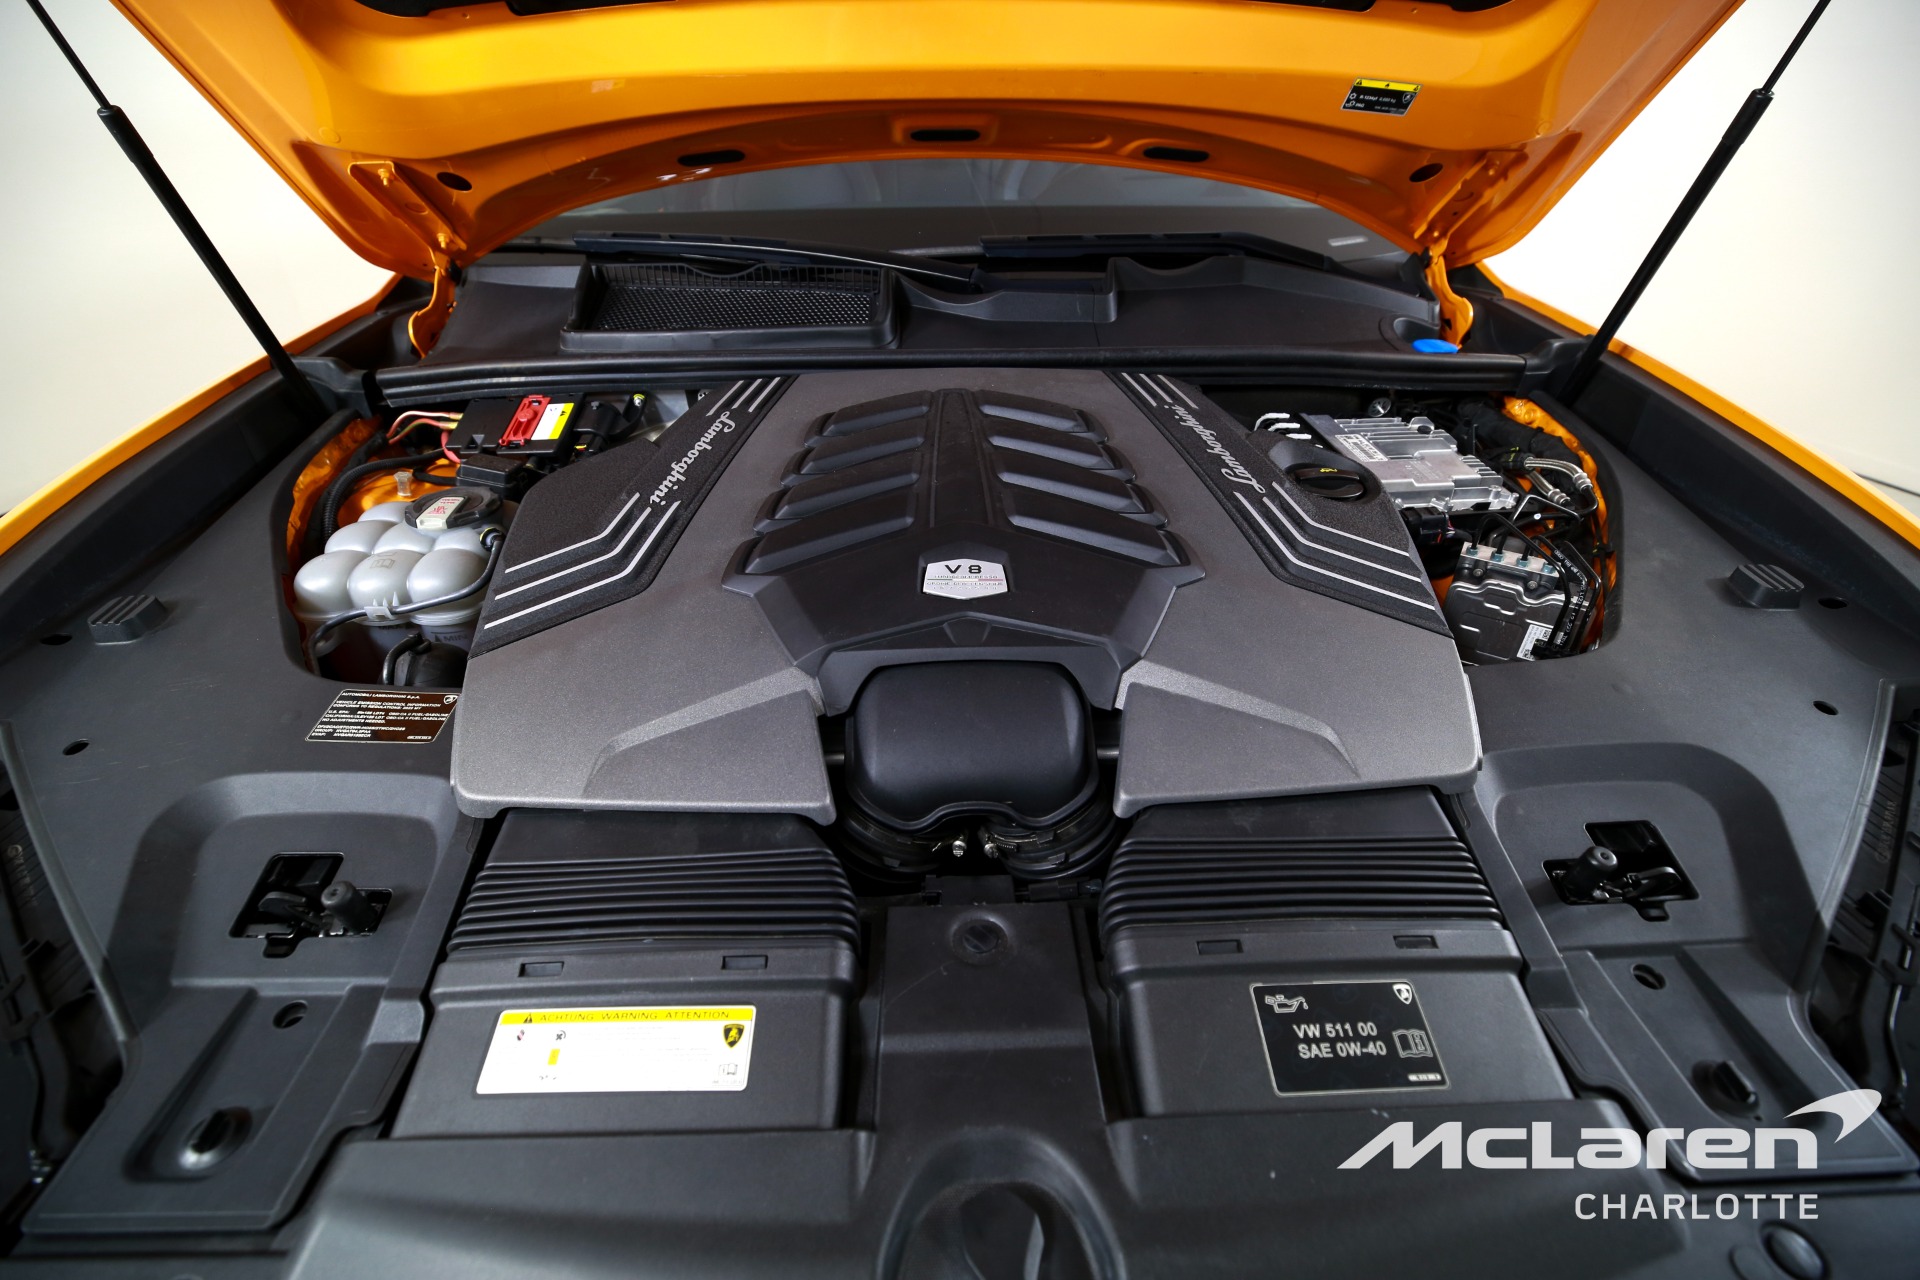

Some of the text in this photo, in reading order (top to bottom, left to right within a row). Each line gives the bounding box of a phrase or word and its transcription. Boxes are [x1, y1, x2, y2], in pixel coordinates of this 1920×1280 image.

[1164, 404, 1266, 494] Lamborghini
[649, 411, 736, 506] Lamborghini
[540, 1011, 730, 1022] ACHTUNG WARNING ATTENTION
[1292, 1022, 1378, 1038] VW 511 00
[1298, 1042, 1387, 1059] SAE 0W-40
